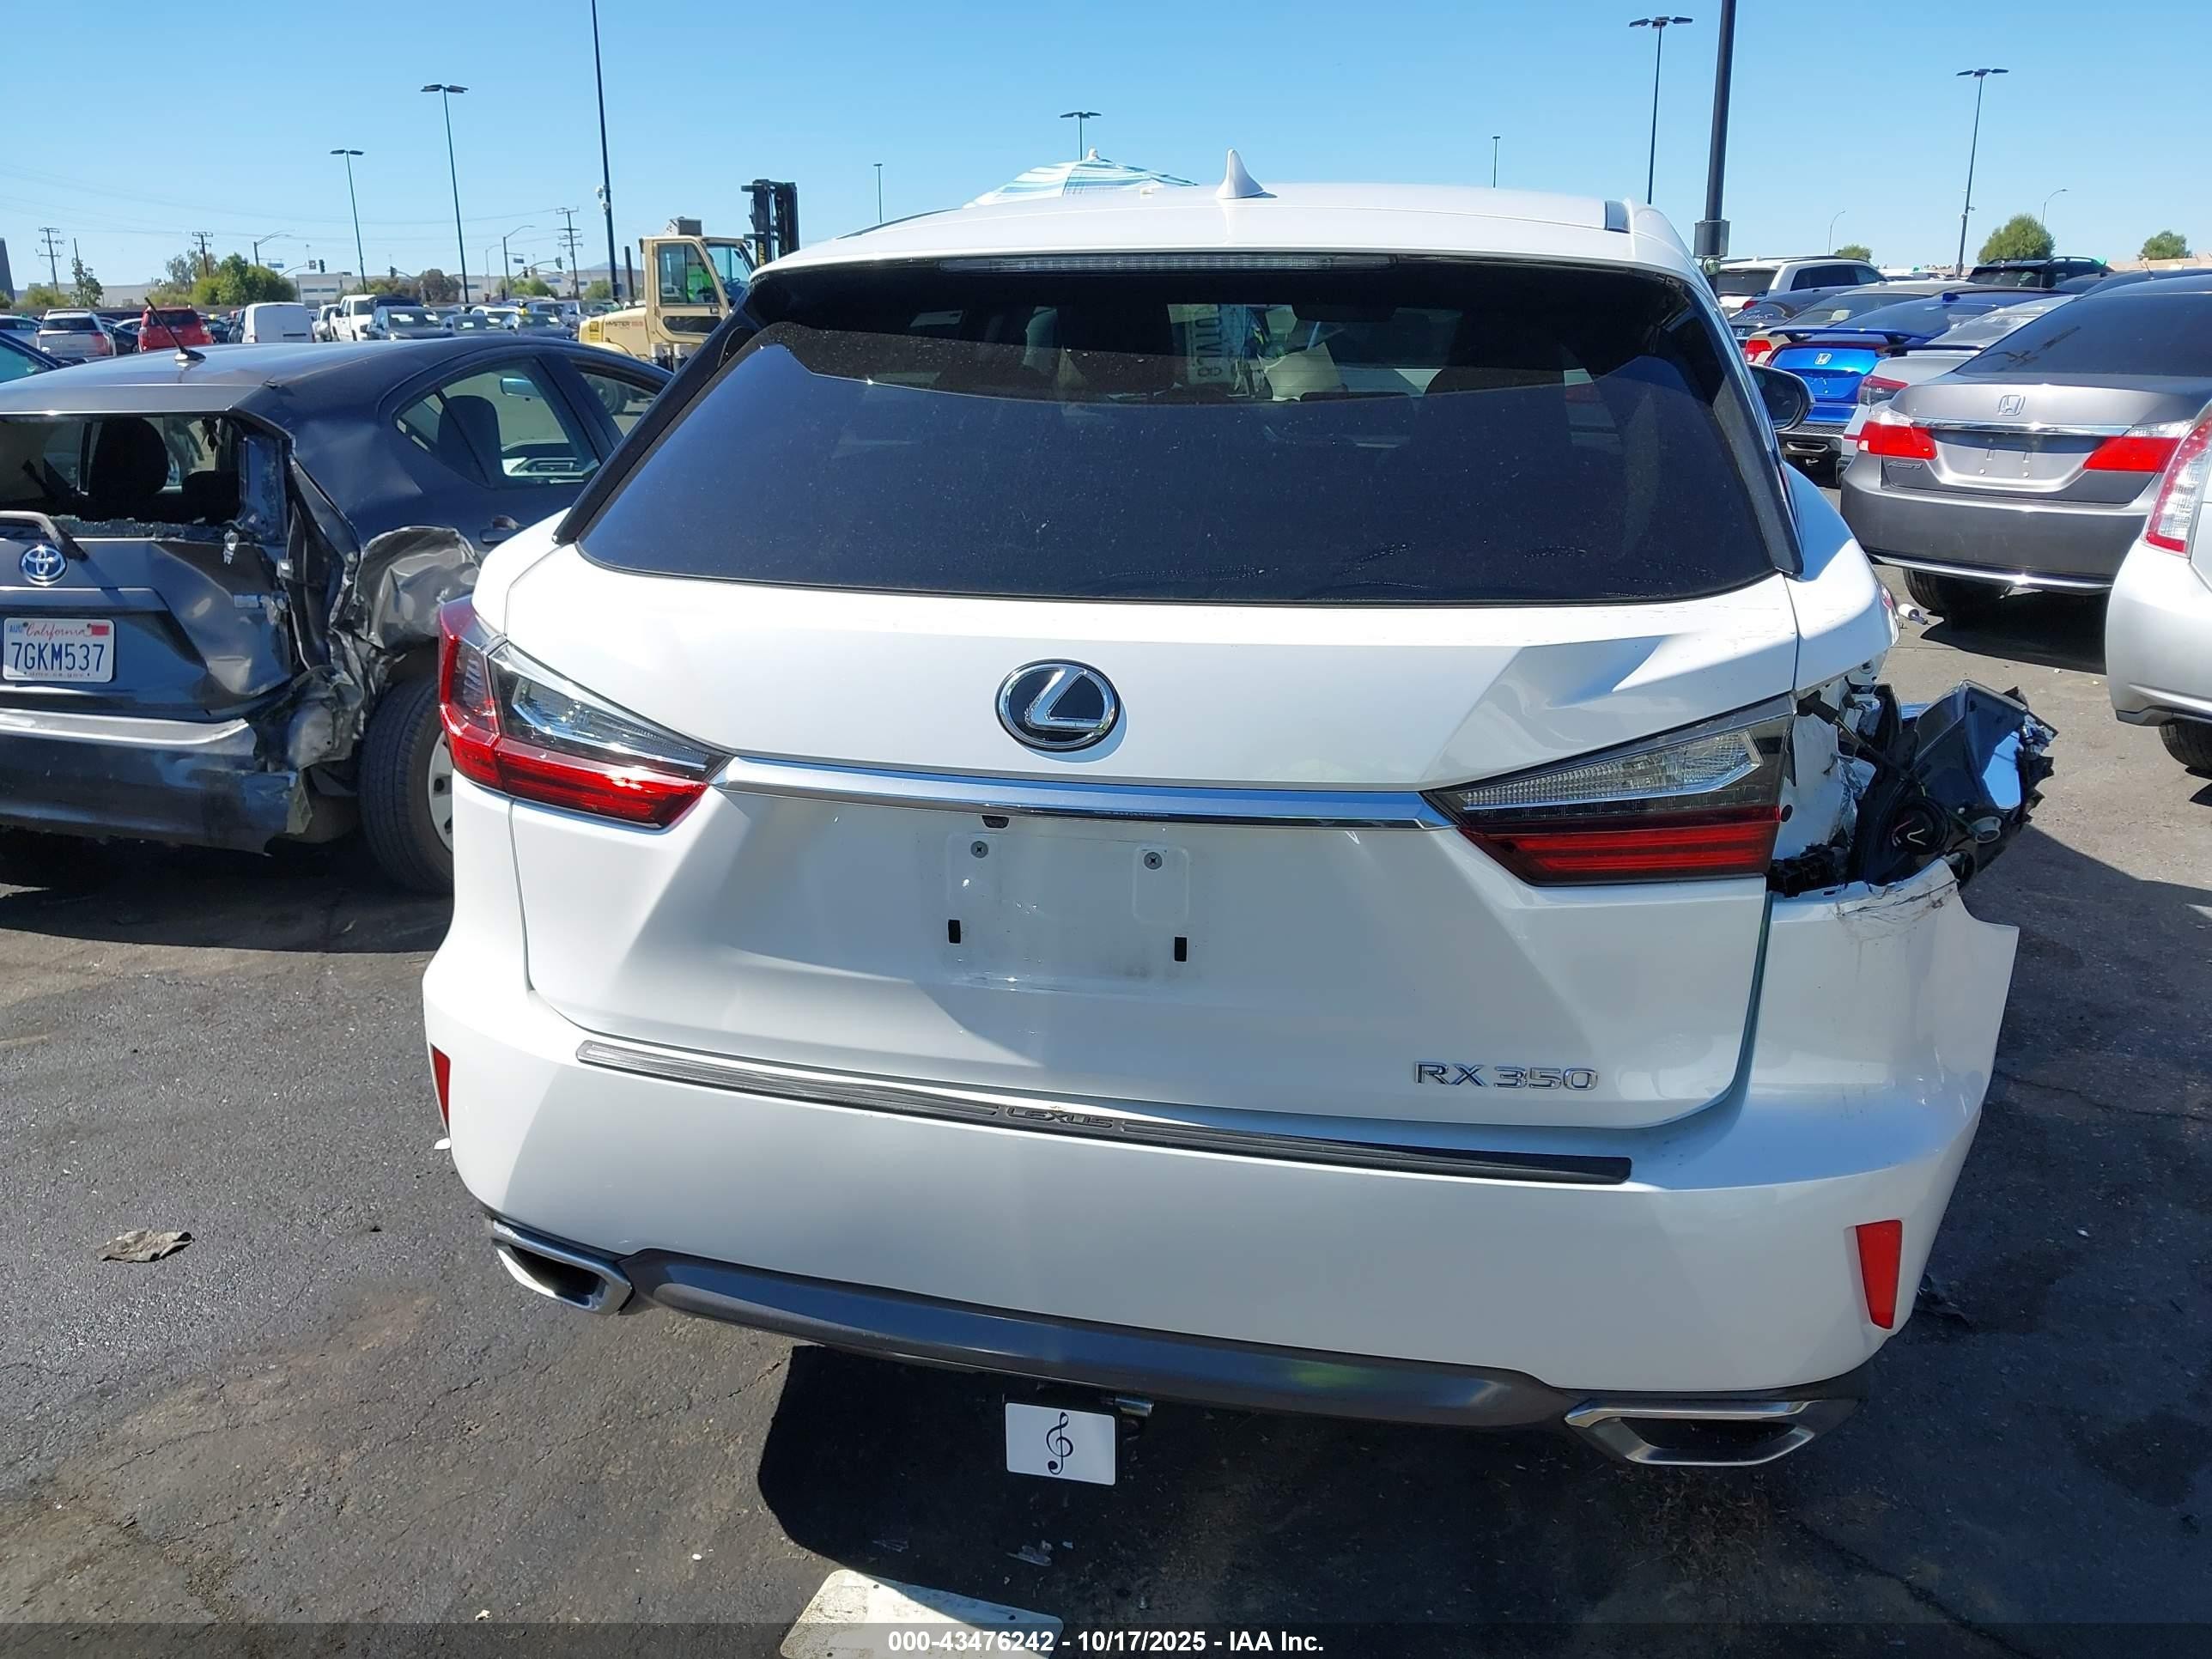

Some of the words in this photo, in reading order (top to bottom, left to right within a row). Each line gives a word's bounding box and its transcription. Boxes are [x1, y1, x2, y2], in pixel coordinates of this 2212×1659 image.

[26, 623, 85, 641] California
[11, 642, 105, 672] 7GKM537
[1414, 1060, 1487, 1087] RX
[1494, 1065, 1599, 1091] 350
[1006, 1106, 1115, 1128] LEXUS
